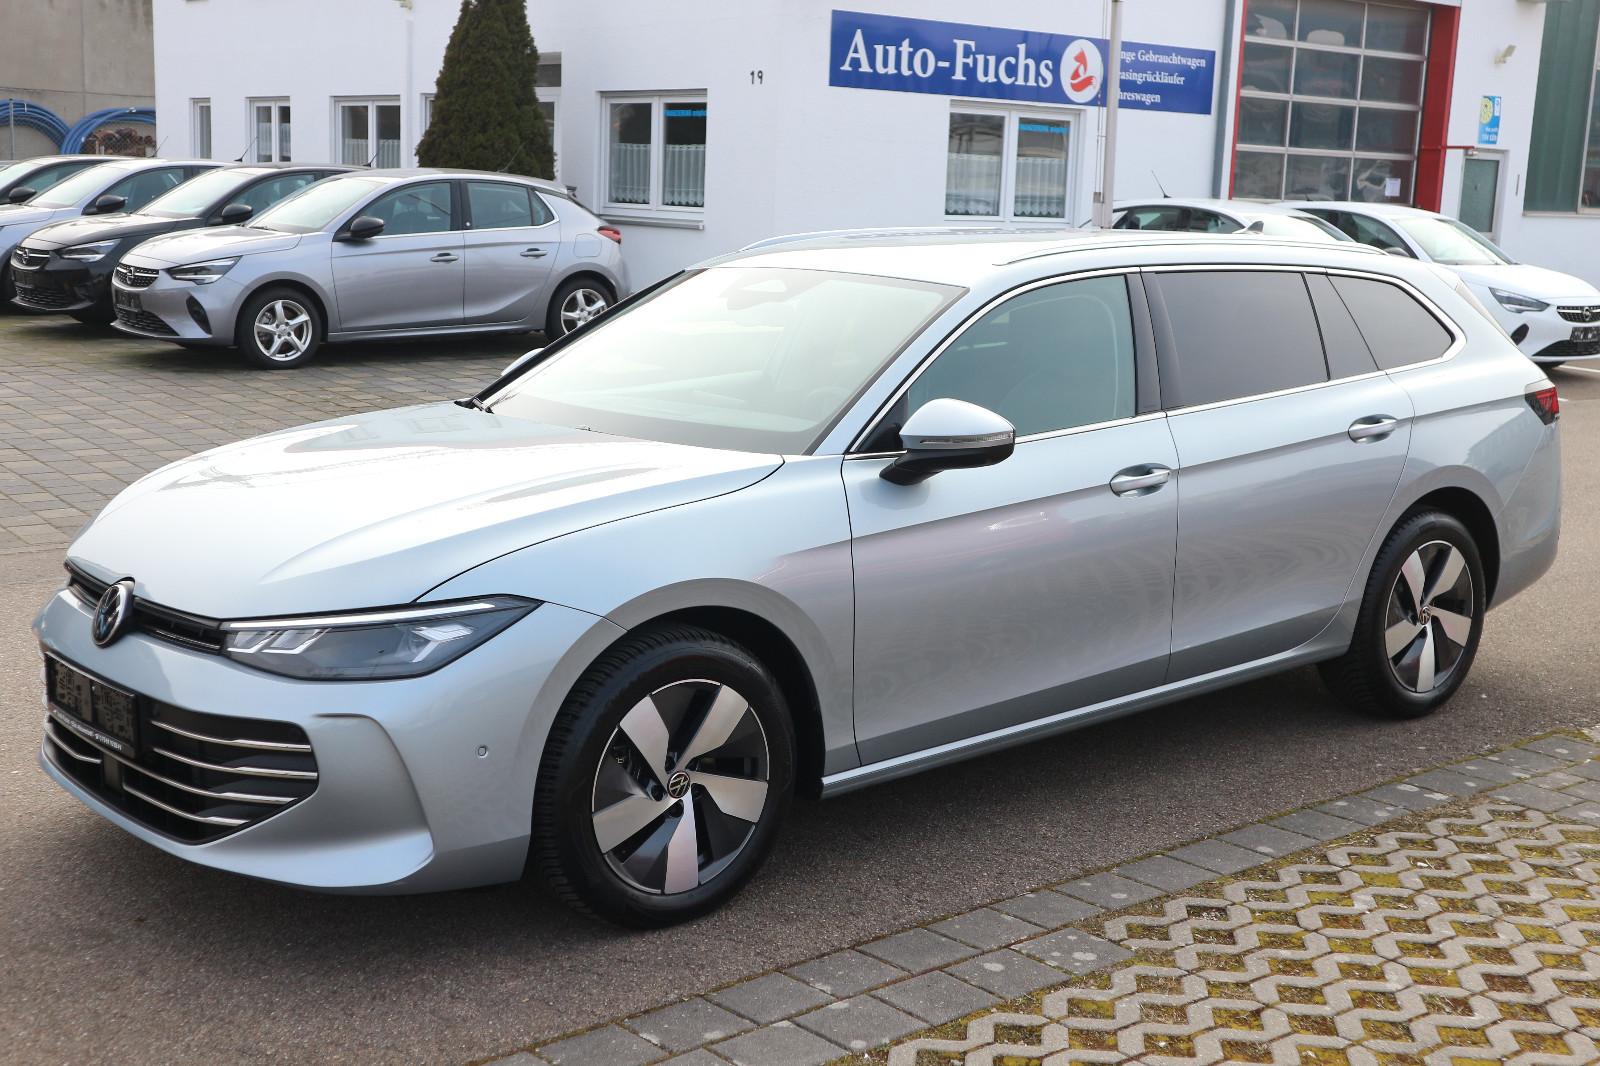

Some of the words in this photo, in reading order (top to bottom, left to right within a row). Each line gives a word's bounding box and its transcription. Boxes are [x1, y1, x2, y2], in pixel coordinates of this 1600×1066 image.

[840, 29, 1053, 88] Auto-Fuchs
[1120, 51, 1136, 63] nge
[1138, 50, 1206, 69] Gebrauchtwagen
[750, 70, 763, 85] 19
[1118, 88, 1161, 105] hreswagen
